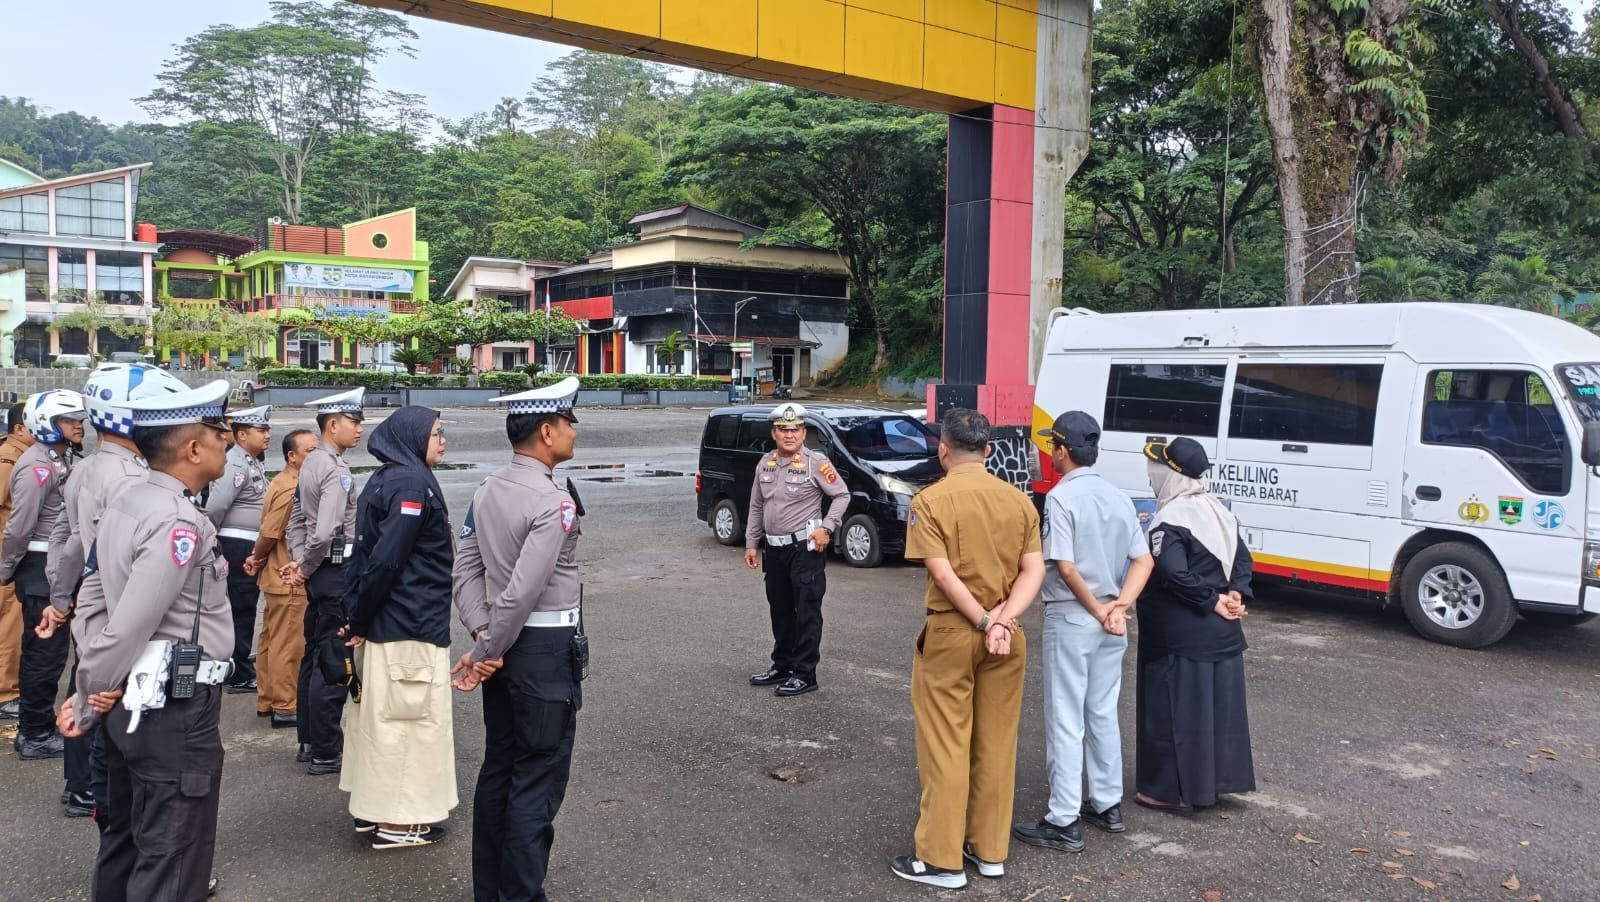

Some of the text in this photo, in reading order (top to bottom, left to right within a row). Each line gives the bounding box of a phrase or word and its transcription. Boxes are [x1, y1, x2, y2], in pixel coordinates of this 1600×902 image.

[1218, 463, 1279, 486] KELILING
[1205, 481, 1299, 503] UMATERA BARAT
